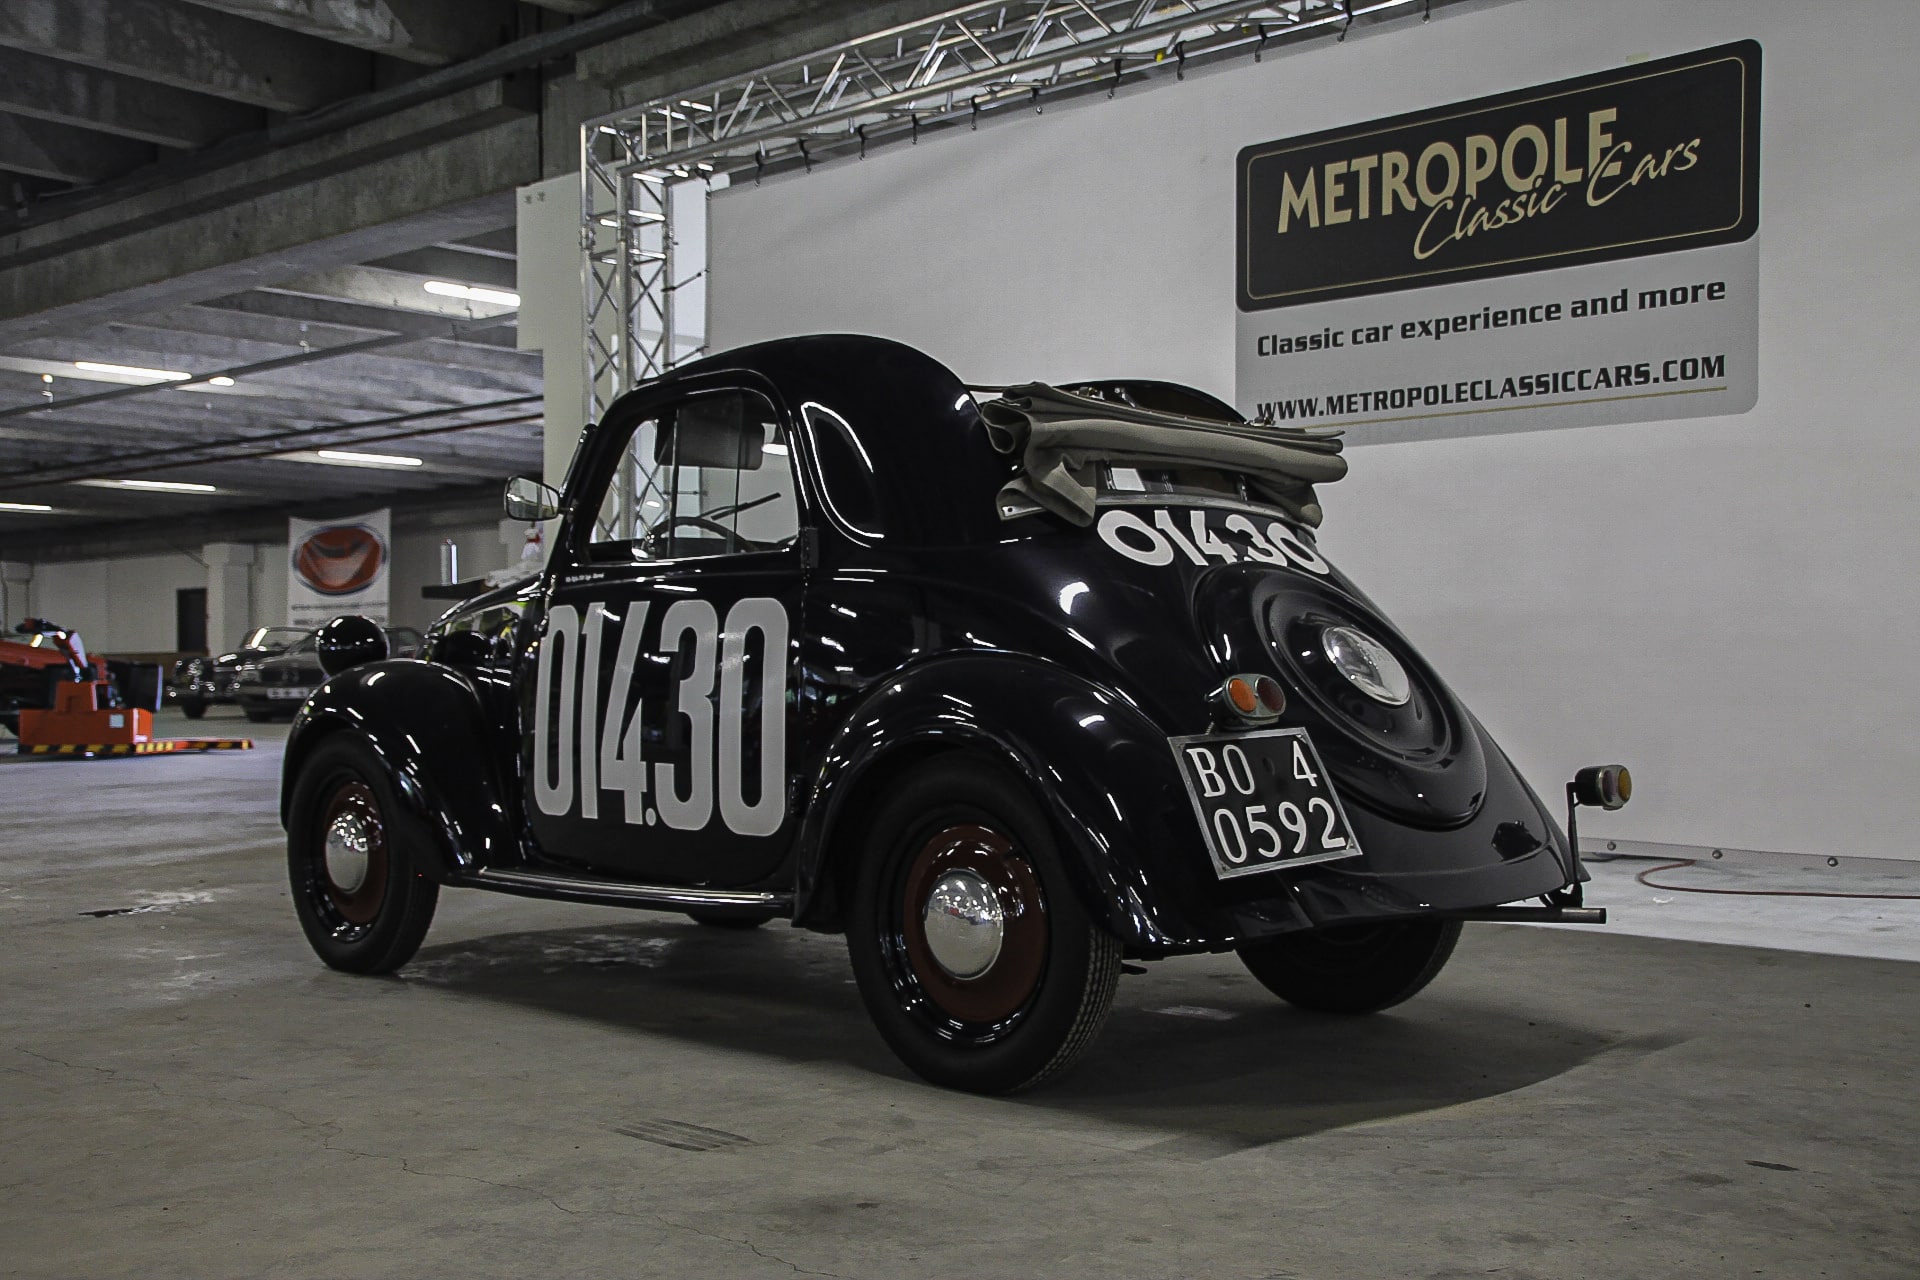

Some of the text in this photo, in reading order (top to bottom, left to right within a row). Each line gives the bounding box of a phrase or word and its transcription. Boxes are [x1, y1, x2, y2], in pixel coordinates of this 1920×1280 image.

[1277, 107, 1618, 234] METROPOLE
[1412, 138, 1701, 260] Classic Cars
[1257, 281, 1726, 357] Classic car experience and more
[1257, 354, 1726, 421] WWW.METROPOLECLASSICCARS.COM
[1097, 509, 1331, 575] 01430
[1292, 740, 1318, 787] 4
[1213, 796, 1347, 864] 0592
